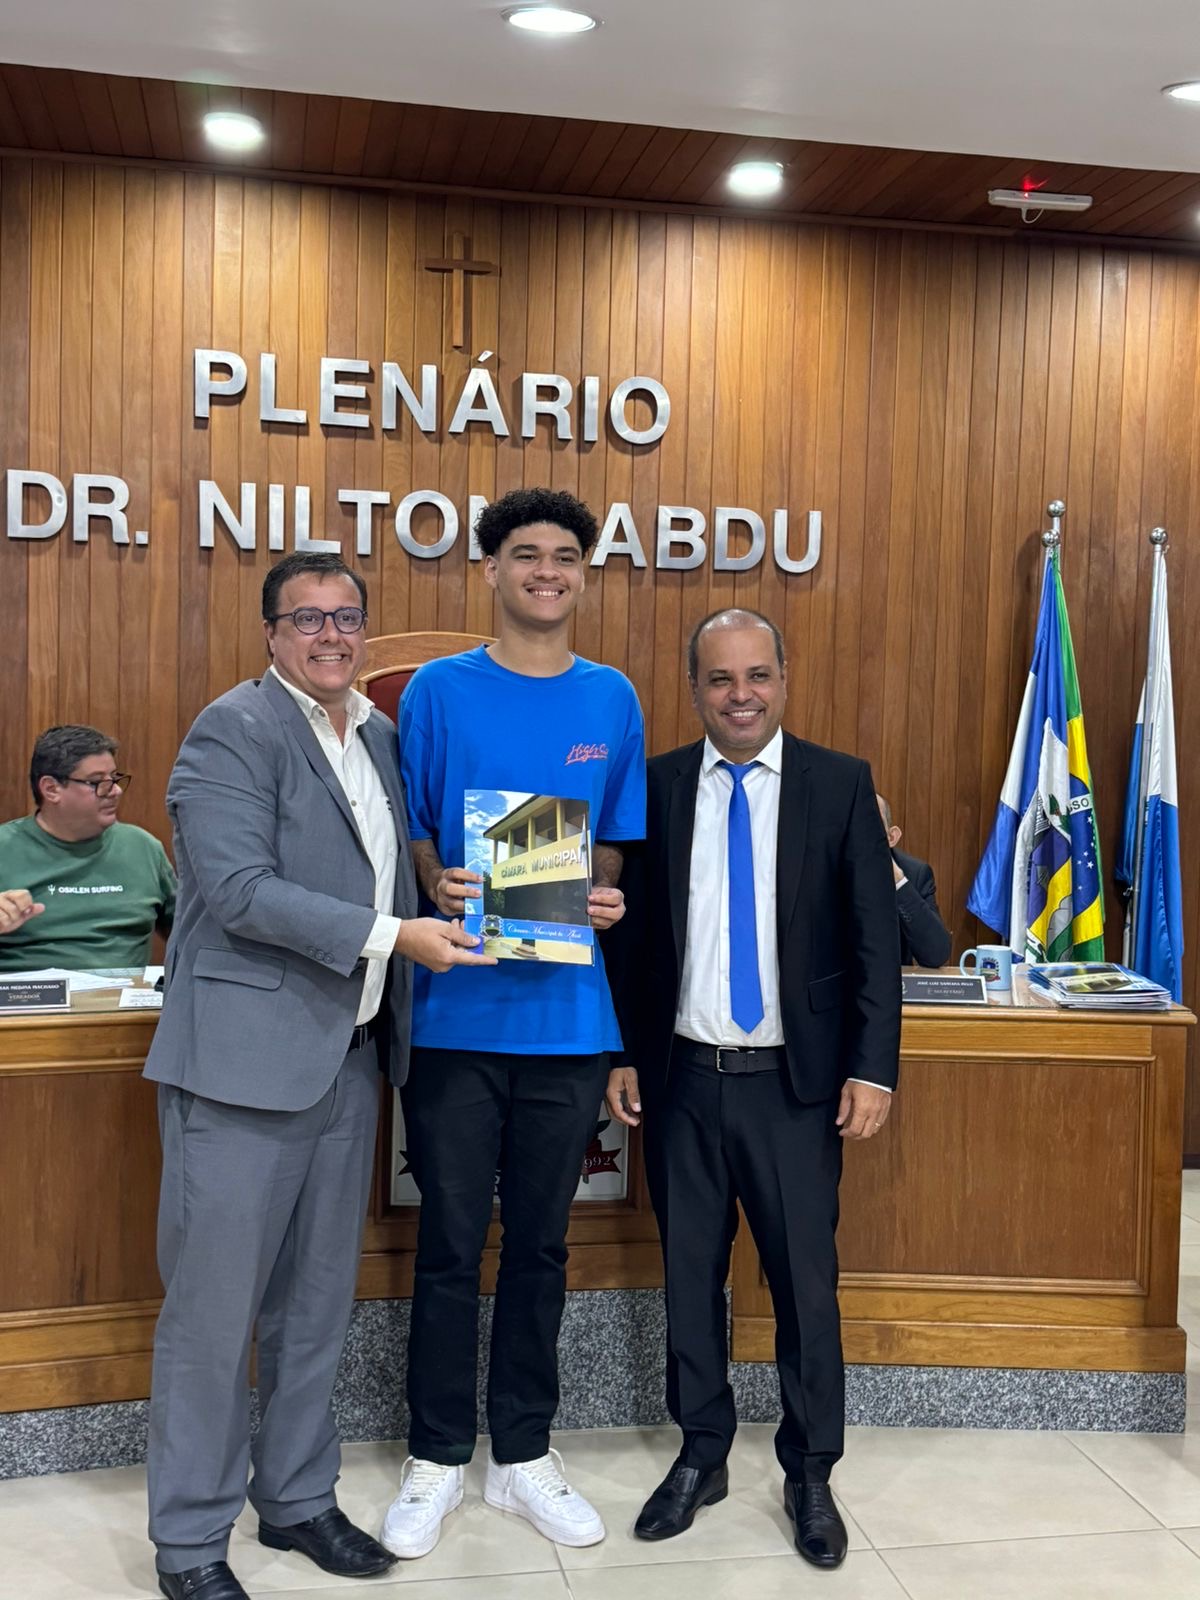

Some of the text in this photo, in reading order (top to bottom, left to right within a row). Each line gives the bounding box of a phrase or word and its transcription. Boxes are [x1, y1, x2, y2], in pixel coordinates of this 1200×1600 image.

[194, 348, 671, 446] PLENÁRIO
[7, 468, 149, 544] DR.
[589, 502, 822, 574] ABDU
[1070, 797, 1090, 812] SO
[58, 884, 123, 894] OSKLEN SURFING
[584, 1156, 612, 1169] 992
